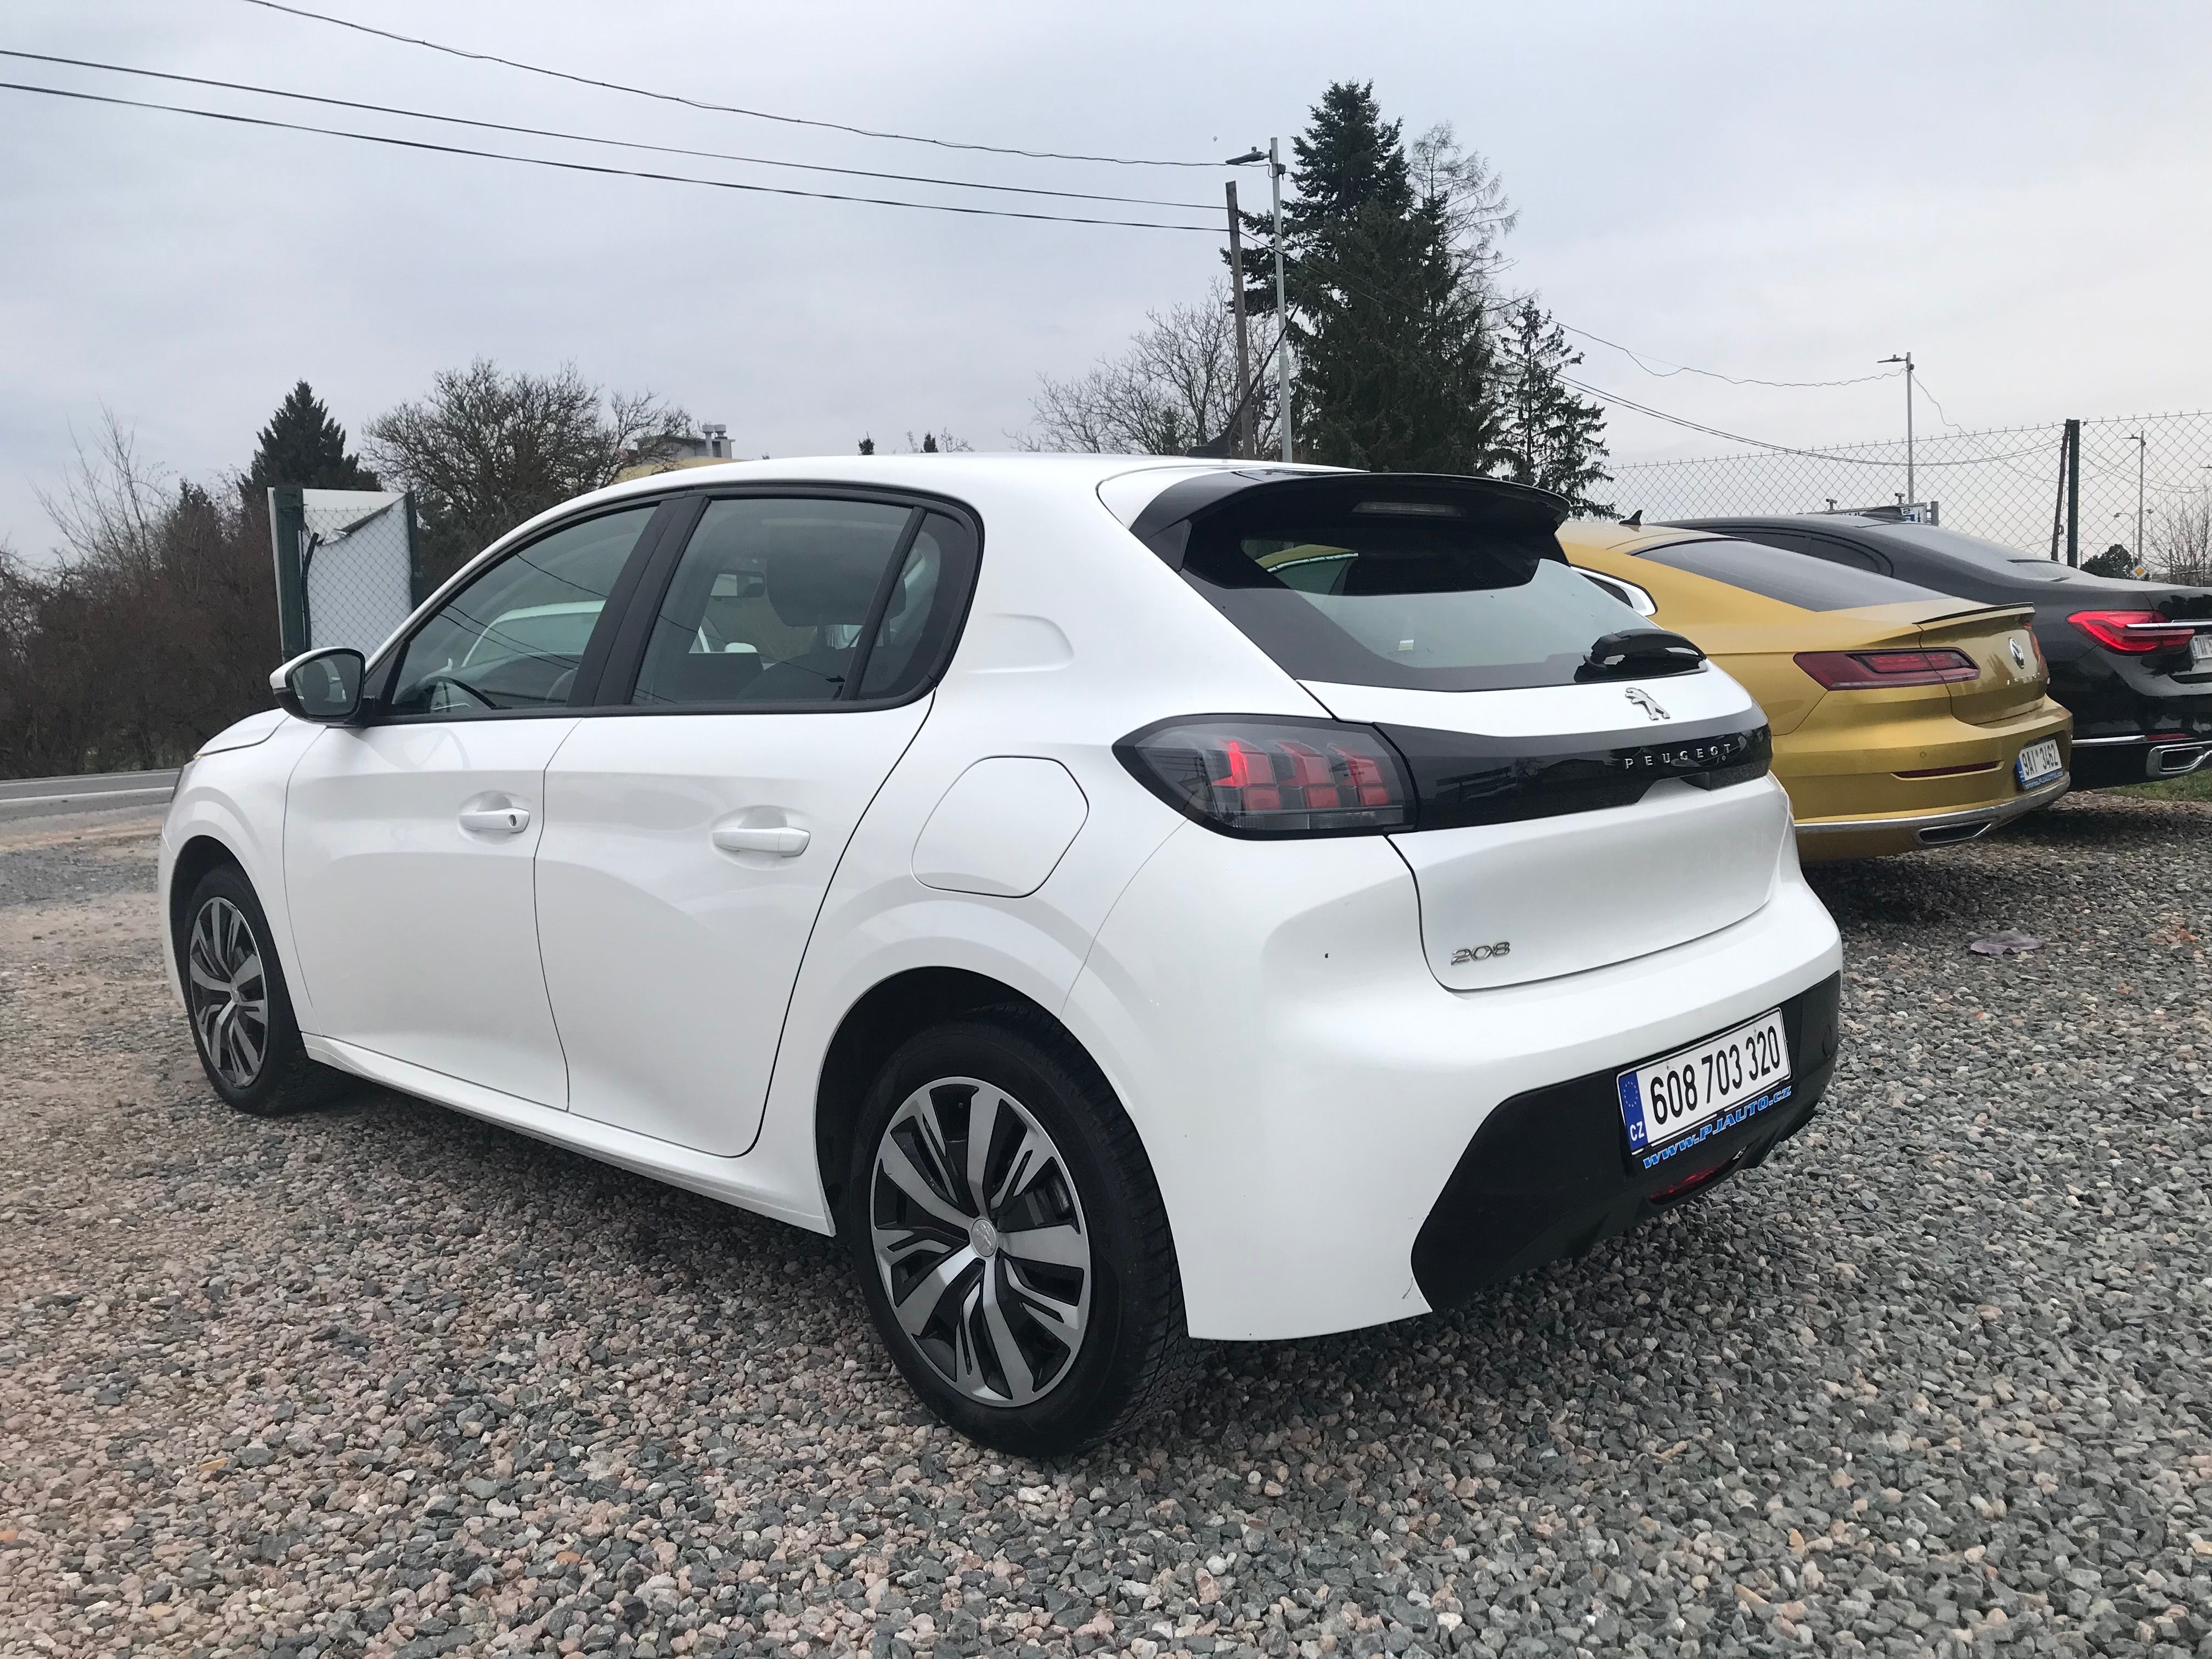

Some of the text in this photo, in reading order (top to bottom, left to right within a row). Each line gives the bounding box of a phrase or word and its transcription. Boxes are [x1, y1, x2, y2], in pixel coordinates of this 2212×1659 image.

[1624, 744, 1730, 769] PEUGEOT
[2040, 743, 2058, 770] 3462
[1451, 941, 1510, 965] 208
[1650, 1025, 1780, 1125] 608 703 320
[1630, 1121, 1645, 1141] CZ
